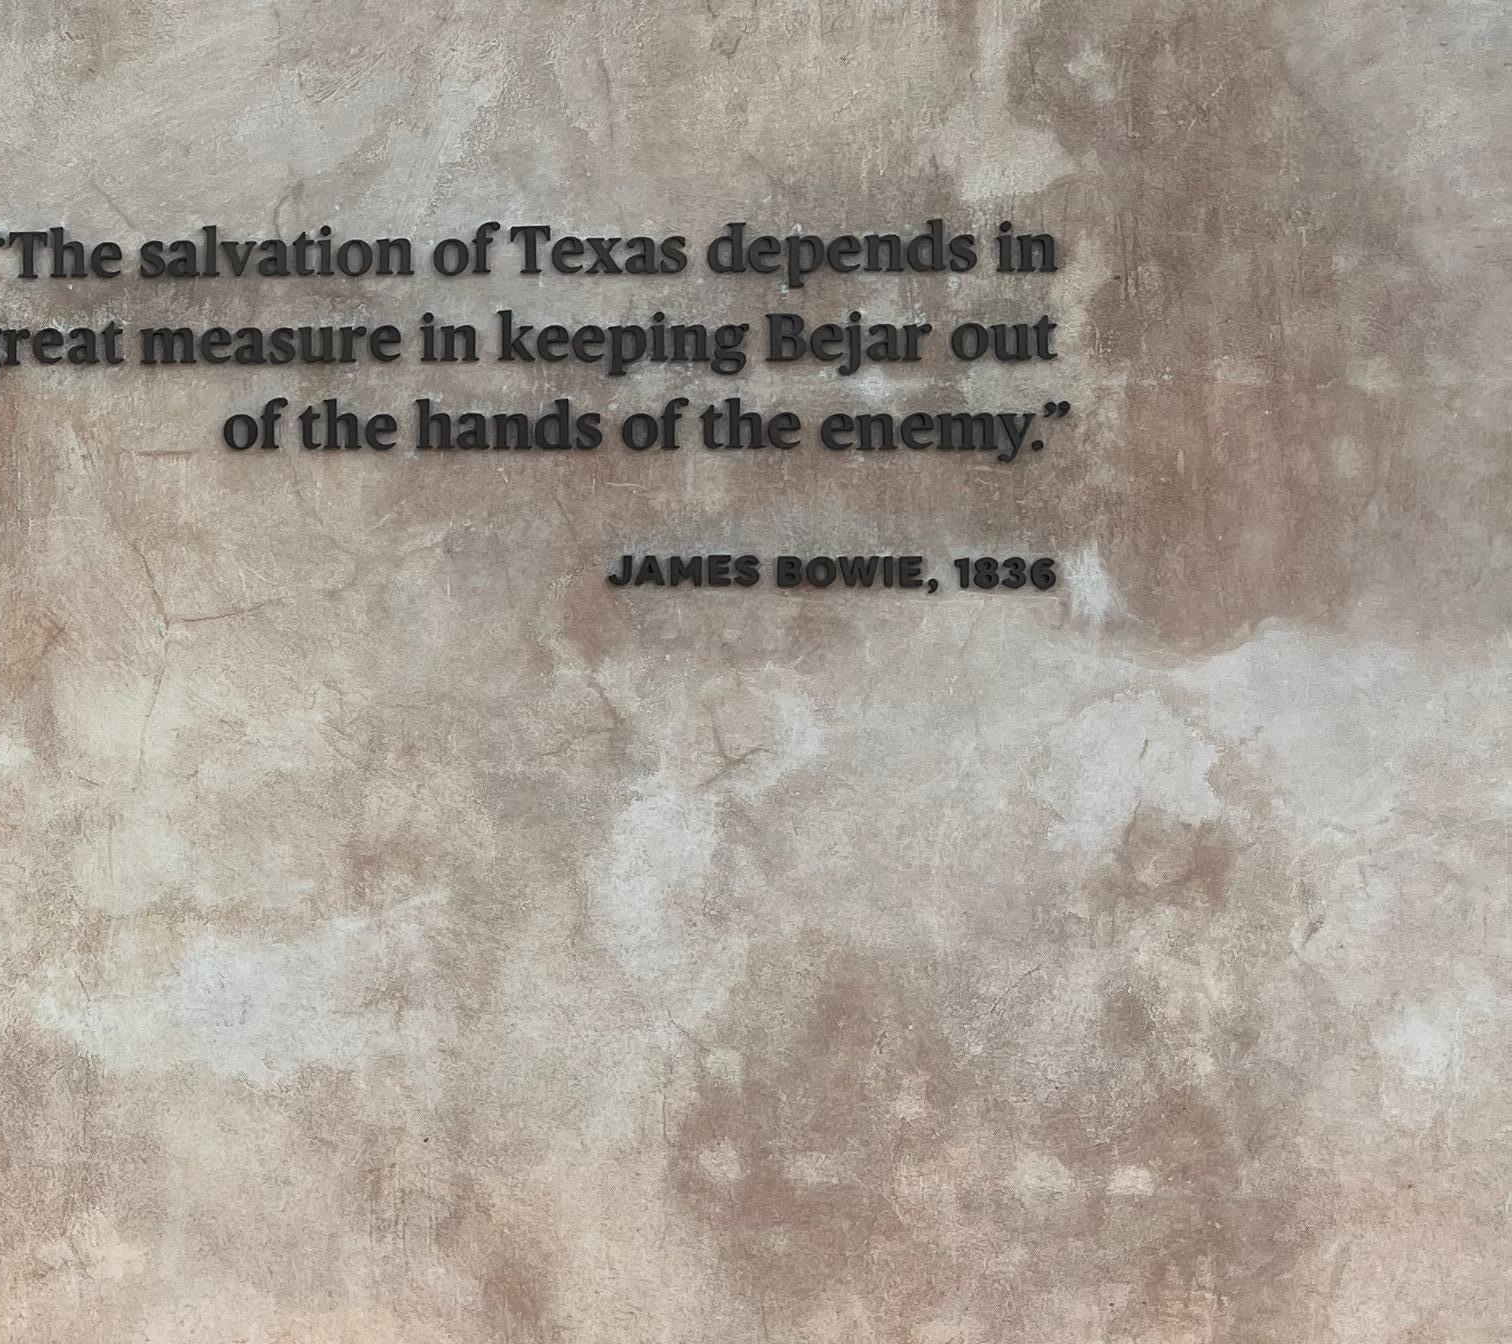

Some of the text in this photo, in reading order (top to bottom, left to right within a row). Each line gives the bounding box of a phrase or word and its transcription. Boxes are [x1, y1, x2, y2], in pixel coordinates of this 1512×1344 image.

[140, 224, 414, 279] salvation
[432, 221, 500, 277] of
[510, 224, 688, 275] Texas
[706, 219, 978, 289] depends
[995, 221, 1058, 274] in
[140, 323, 402, 365] measure
[420, 312, 479, 363] in
[497, 309, 750, 377] keeping
[765, 311, 932, 377] Bejar
[950, 315, 1059, 361] out
[223, 397, 1071, 462] of the hands of the enemy.”
[608, 554, 1057, 594] JAMES BOWIE, 1836
